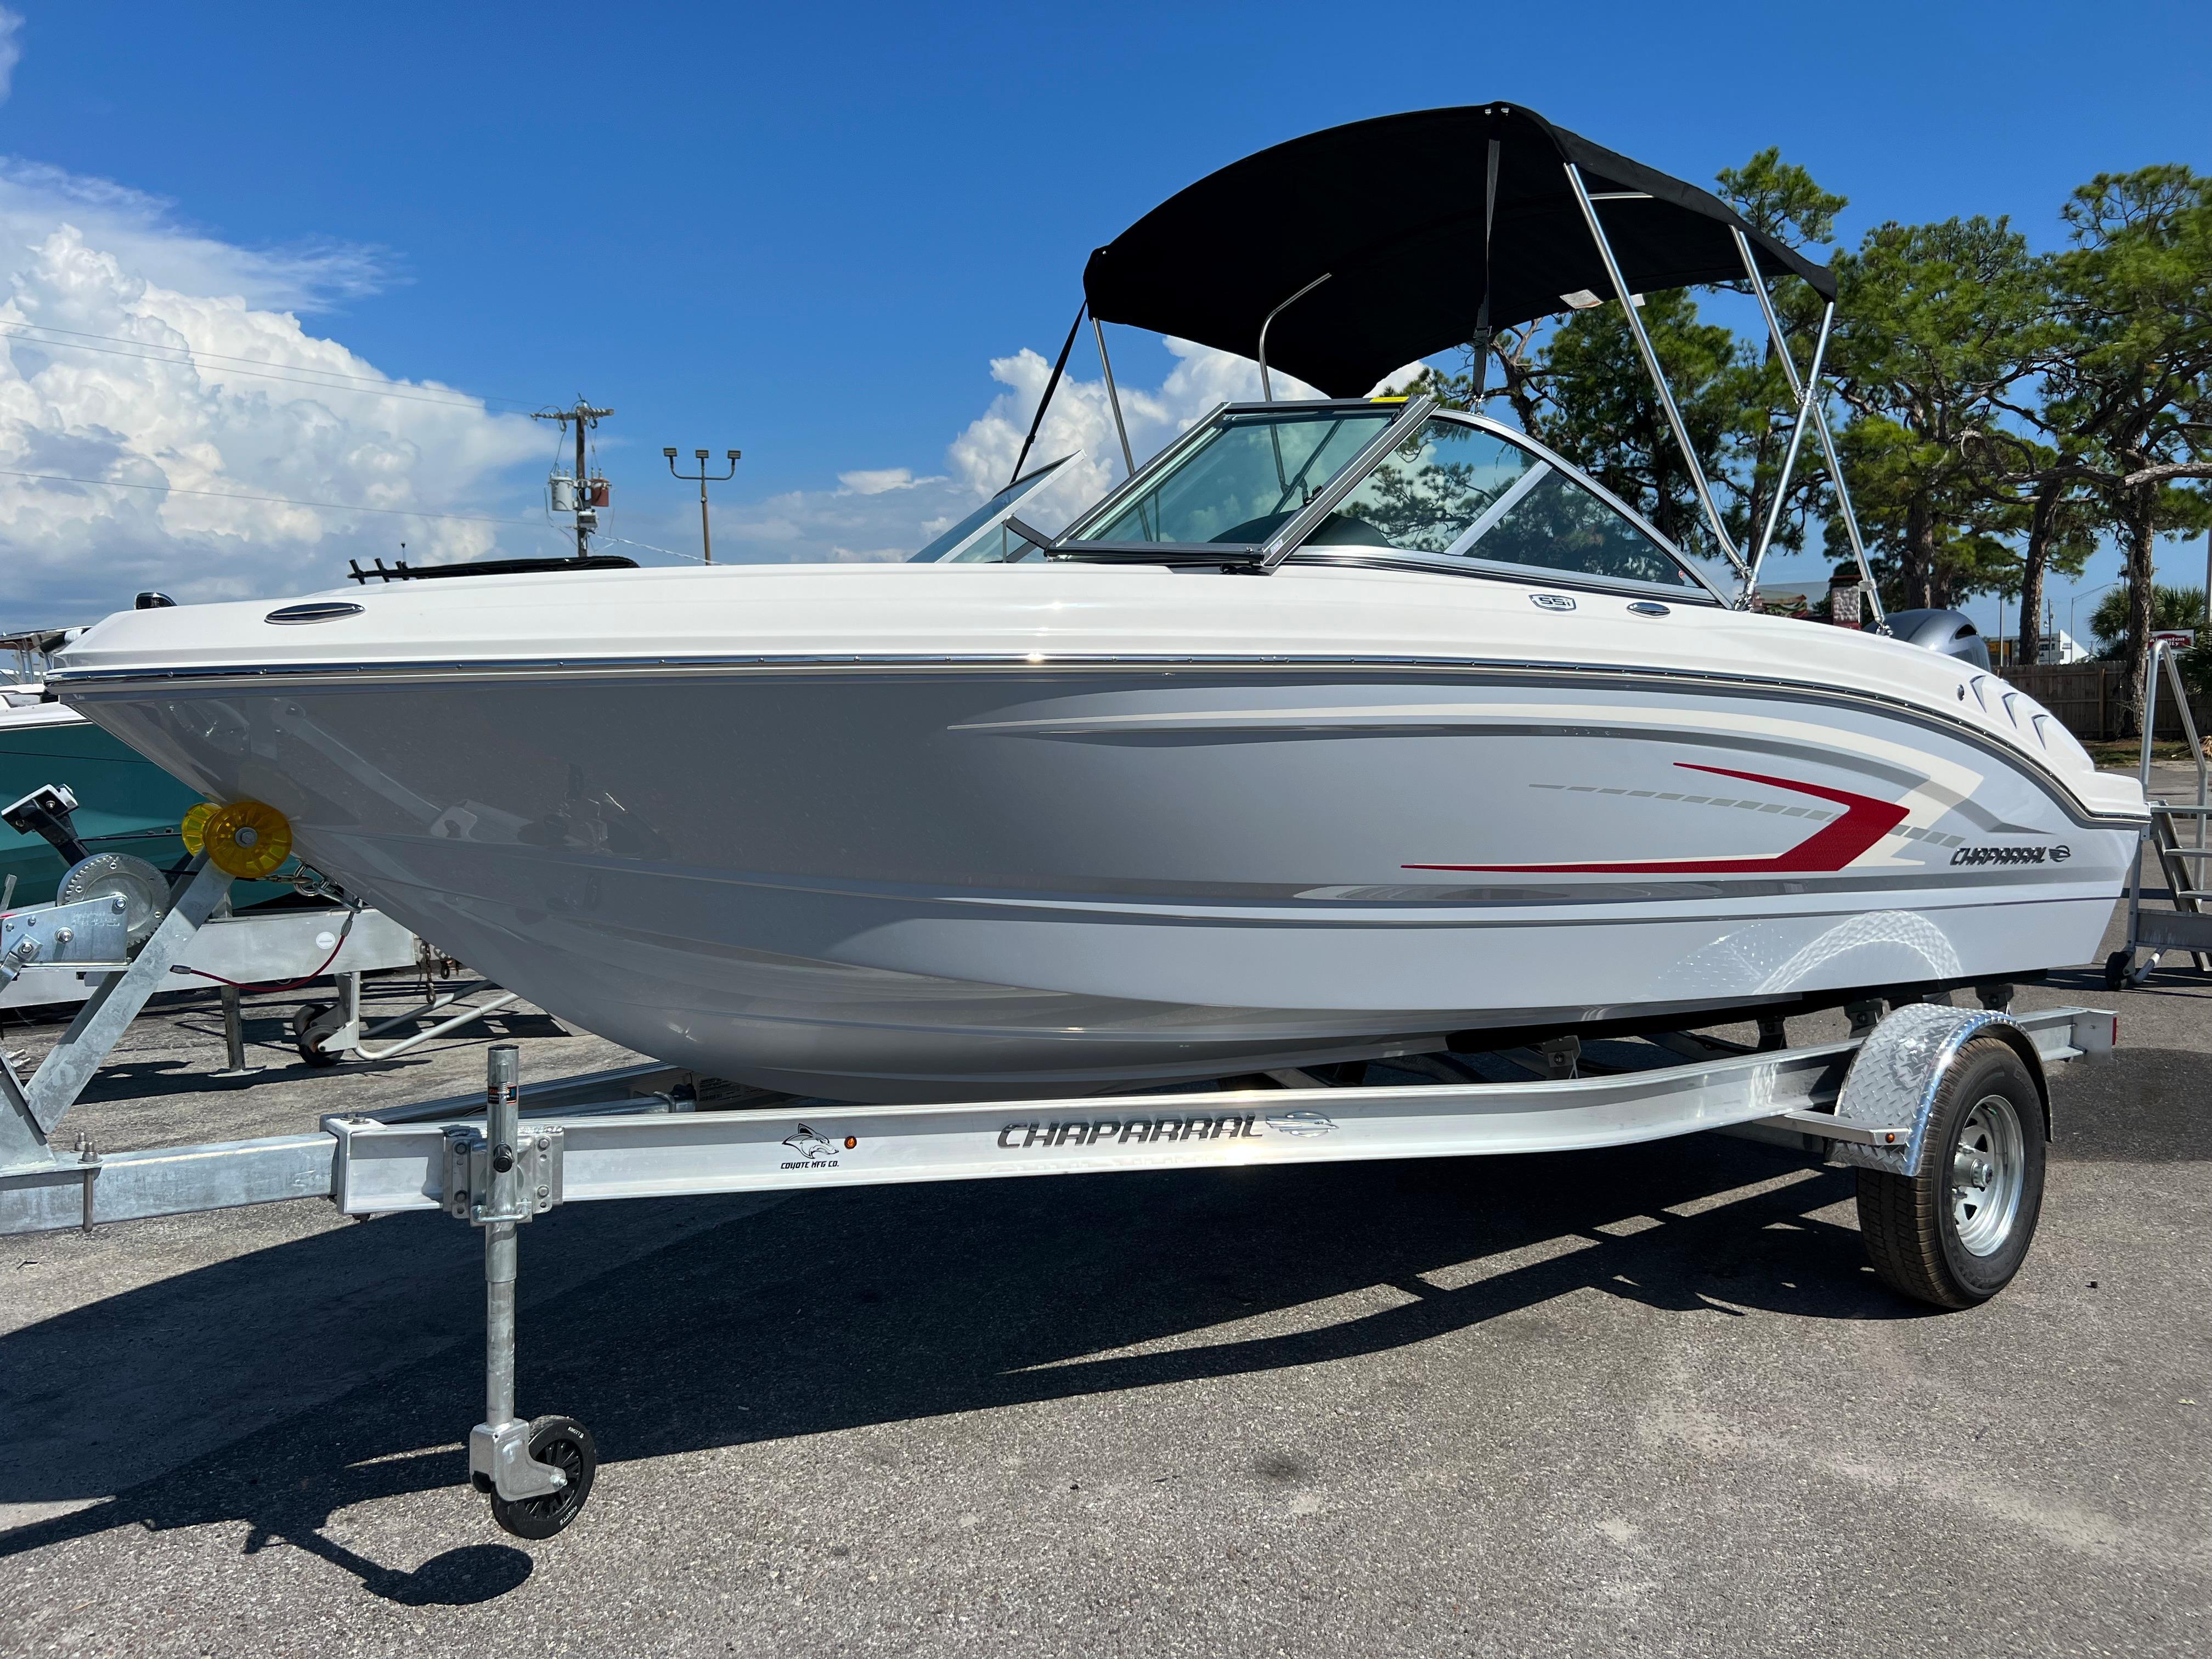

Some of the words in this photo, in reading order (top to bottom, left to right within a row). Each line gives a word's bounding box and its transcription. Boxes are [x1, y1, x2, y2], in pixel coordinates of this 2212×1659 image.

[1949, 847, 2047, 866] CHAPARRAL
[997, 1114, 1263, 1149] CHAPARRAL
[781, 1161, 810, 1170] COYOTE
[811, 1160, 828, 1169] MFG
